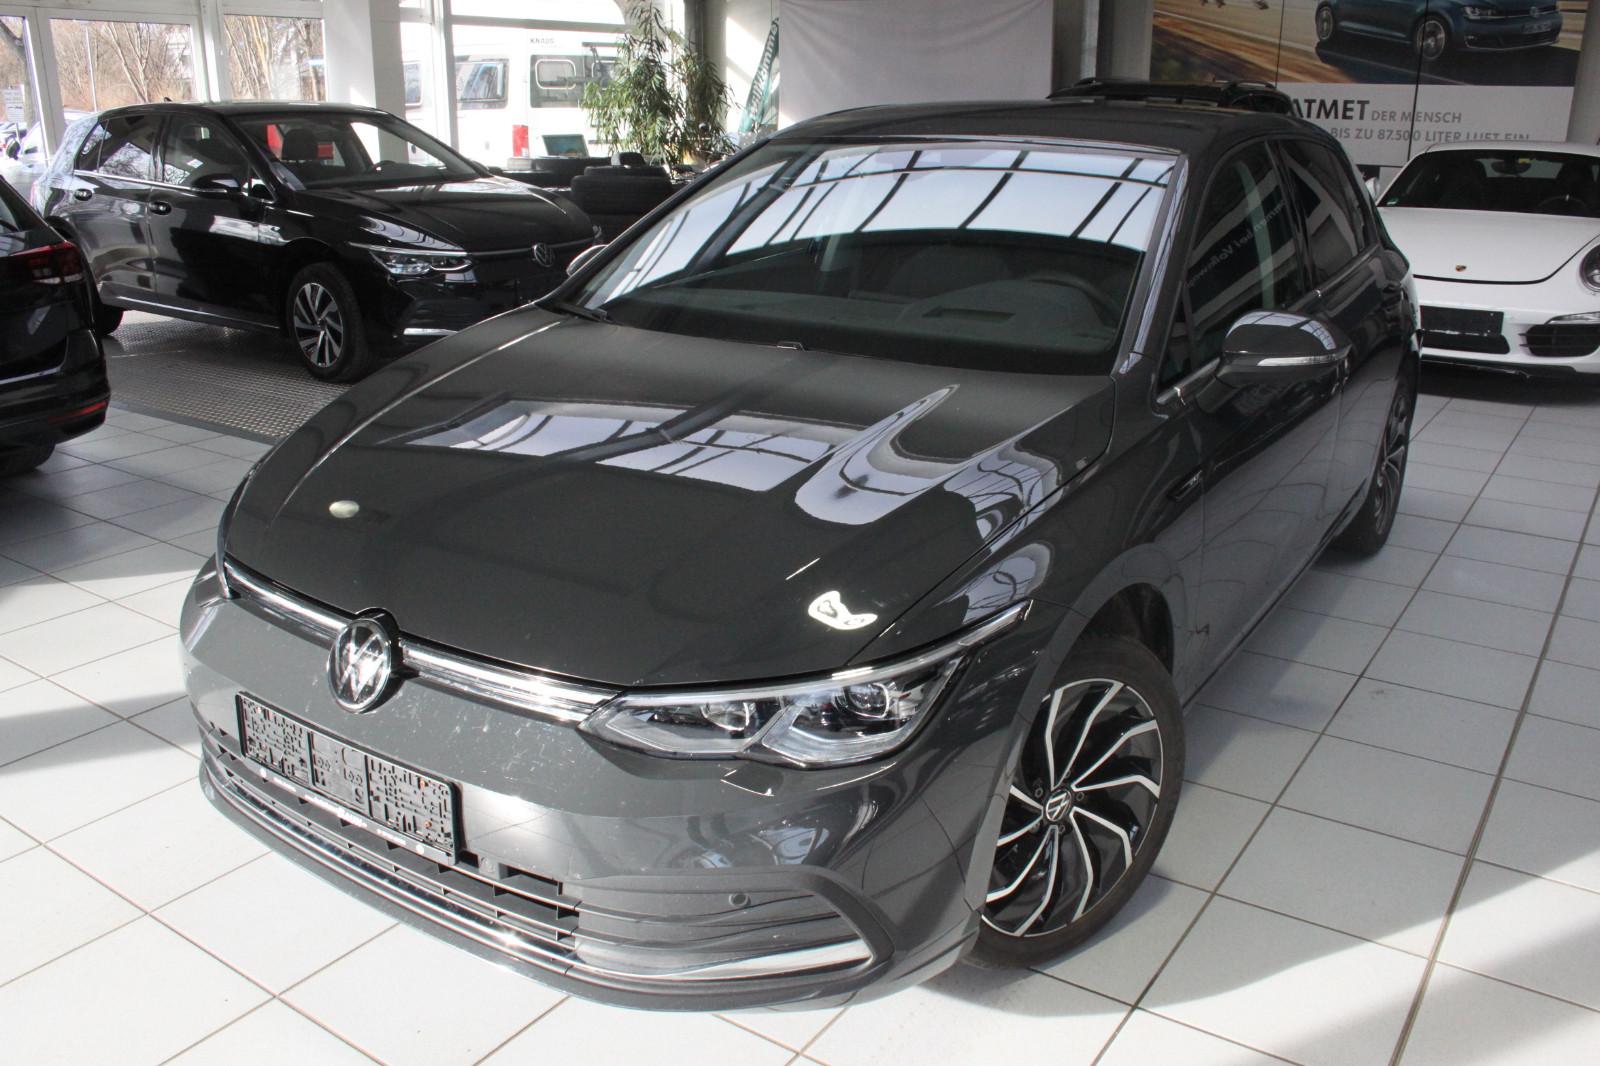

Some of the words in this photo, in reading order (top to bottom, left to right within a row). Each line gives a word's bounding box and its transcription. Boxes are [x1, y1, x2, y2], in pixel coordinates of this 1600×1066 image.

[1371, 110, 1396, 121] DER
[1400, 111, 1462, 123] MENSCH
[1331, 128, 1351, 139] BIS
[1355, 128, 1374, 140] ZU
[1377, 129, 1421, 141] 87.500
[1425, 131, 1462, 142] LITER
